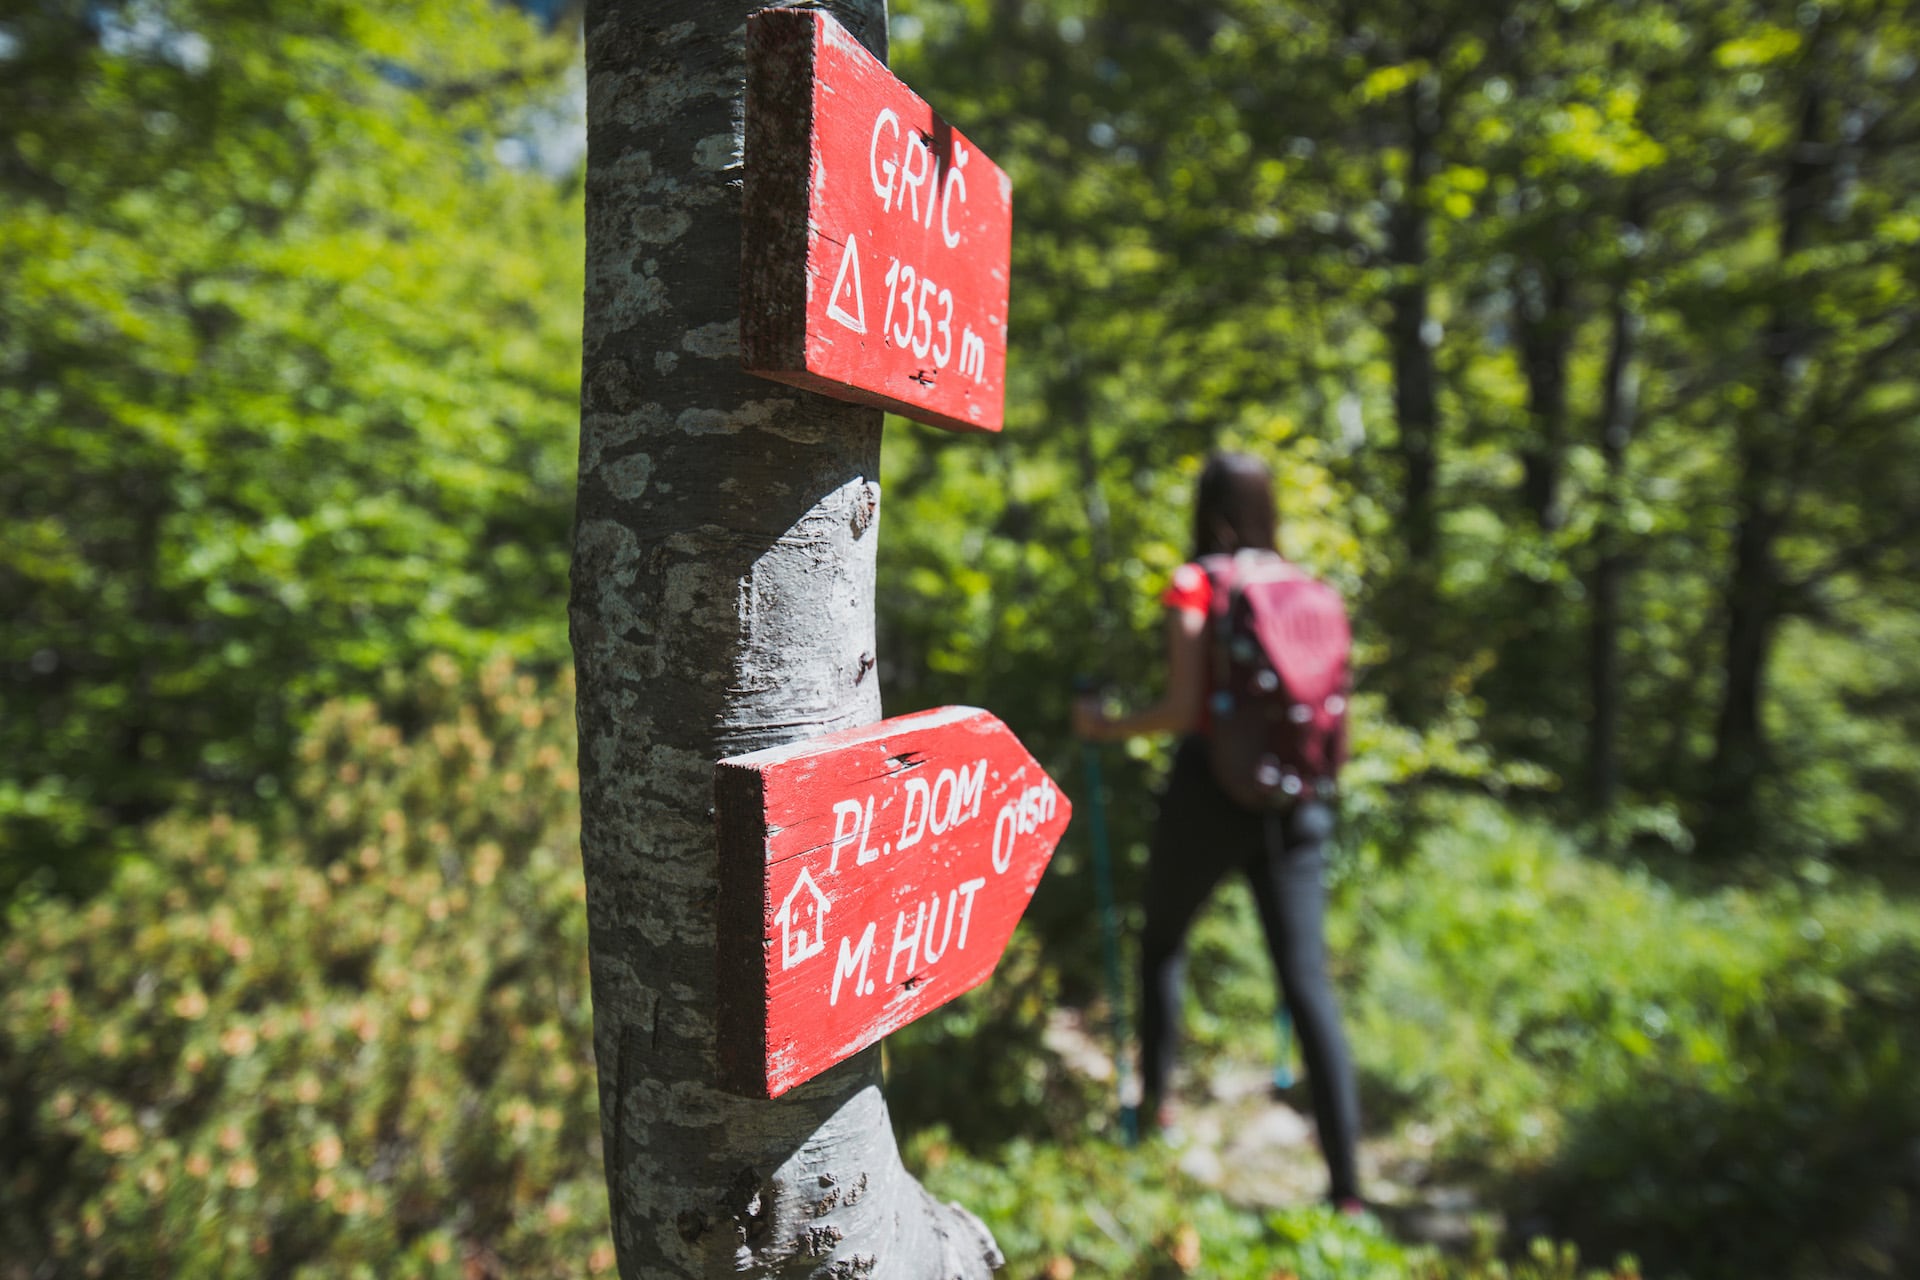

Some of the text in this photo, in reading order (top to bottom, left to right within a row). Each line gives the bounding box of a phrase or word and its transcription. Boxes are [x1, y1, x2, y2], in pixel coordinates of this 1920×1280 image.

[870, 108, 968, 248] GRIČ
[884, 258, 986, 384] 1353 m
[830, 759, 987, 874] PL. DOM
[830, 877, 985, 1007] M. HUT
